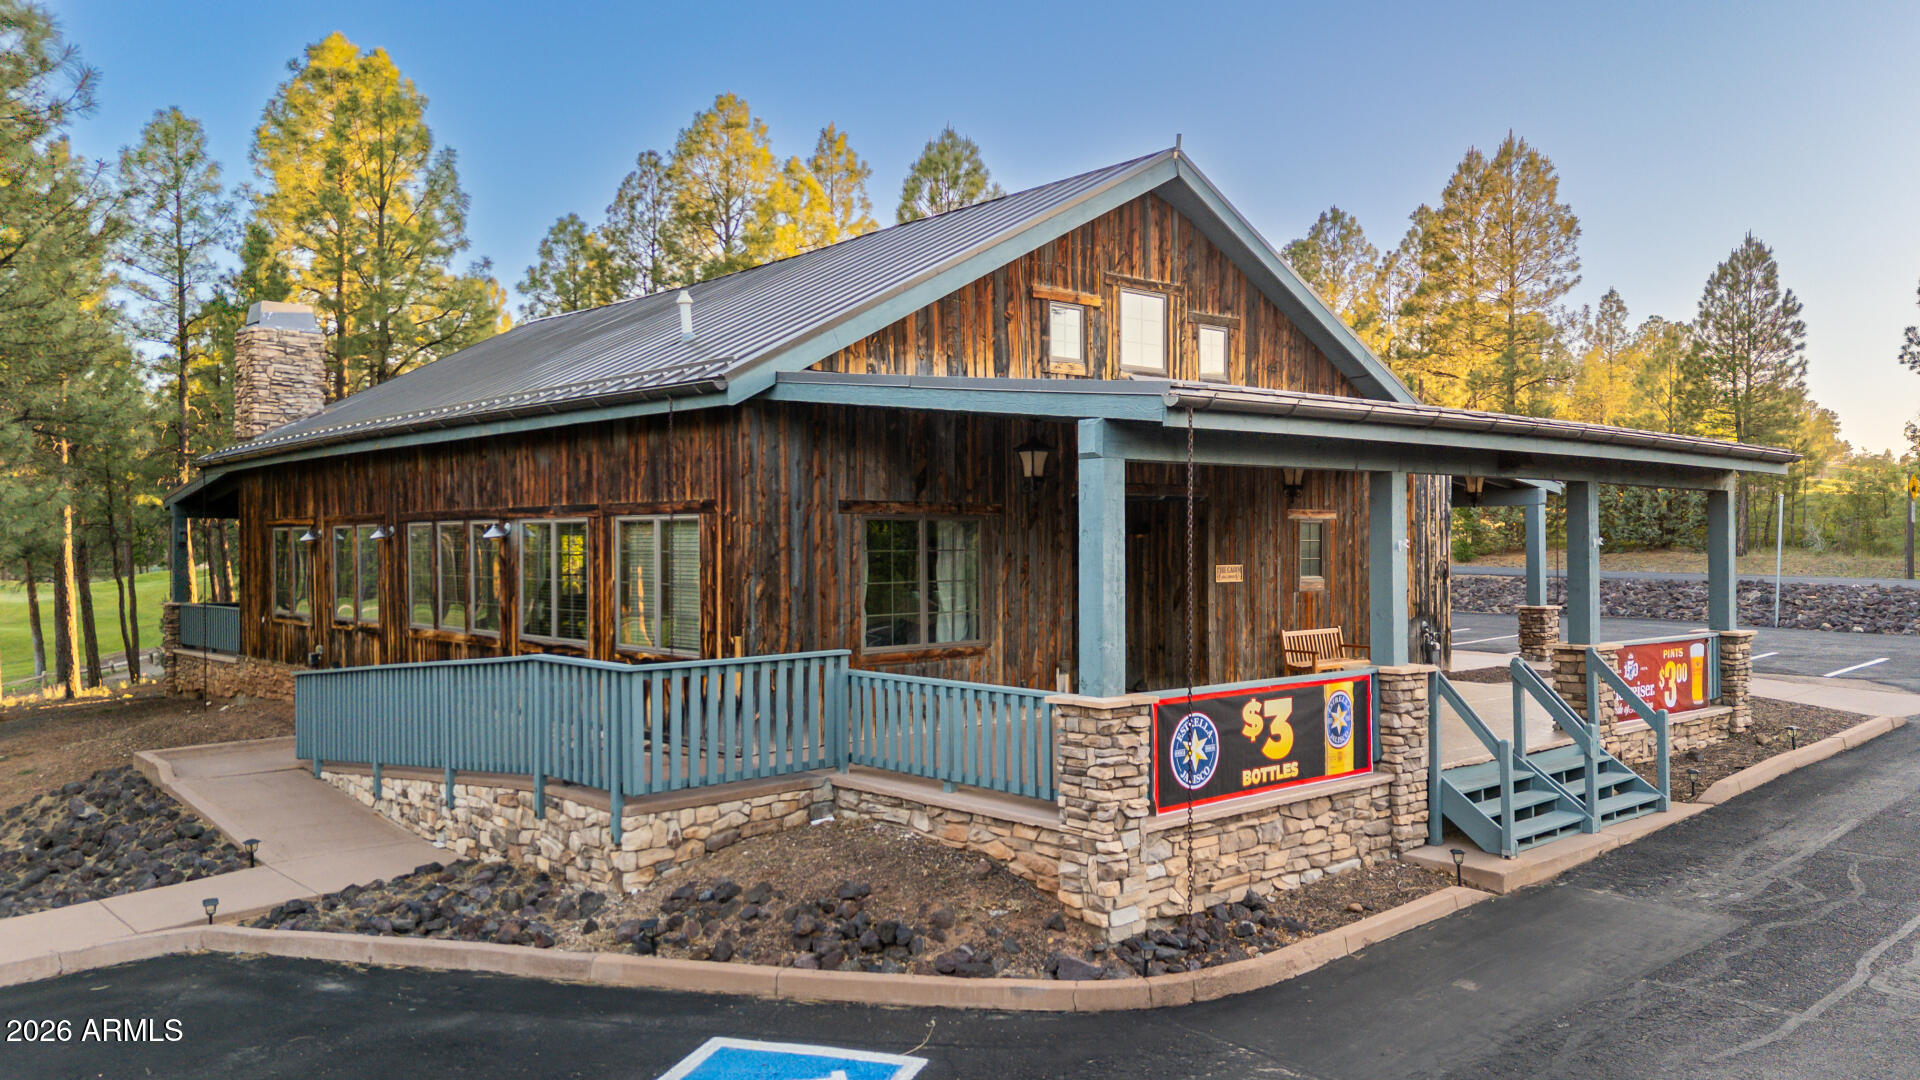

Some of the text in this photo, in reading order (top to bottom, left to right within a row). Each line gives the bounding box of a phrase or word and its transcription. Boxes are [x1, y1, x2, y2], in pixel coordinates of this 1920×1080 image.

[1663, 648, 1683, 658] PINTS
[1241, 697, 1294, 760] $3
[1242, 762, 1298, 787] BOTTLES
